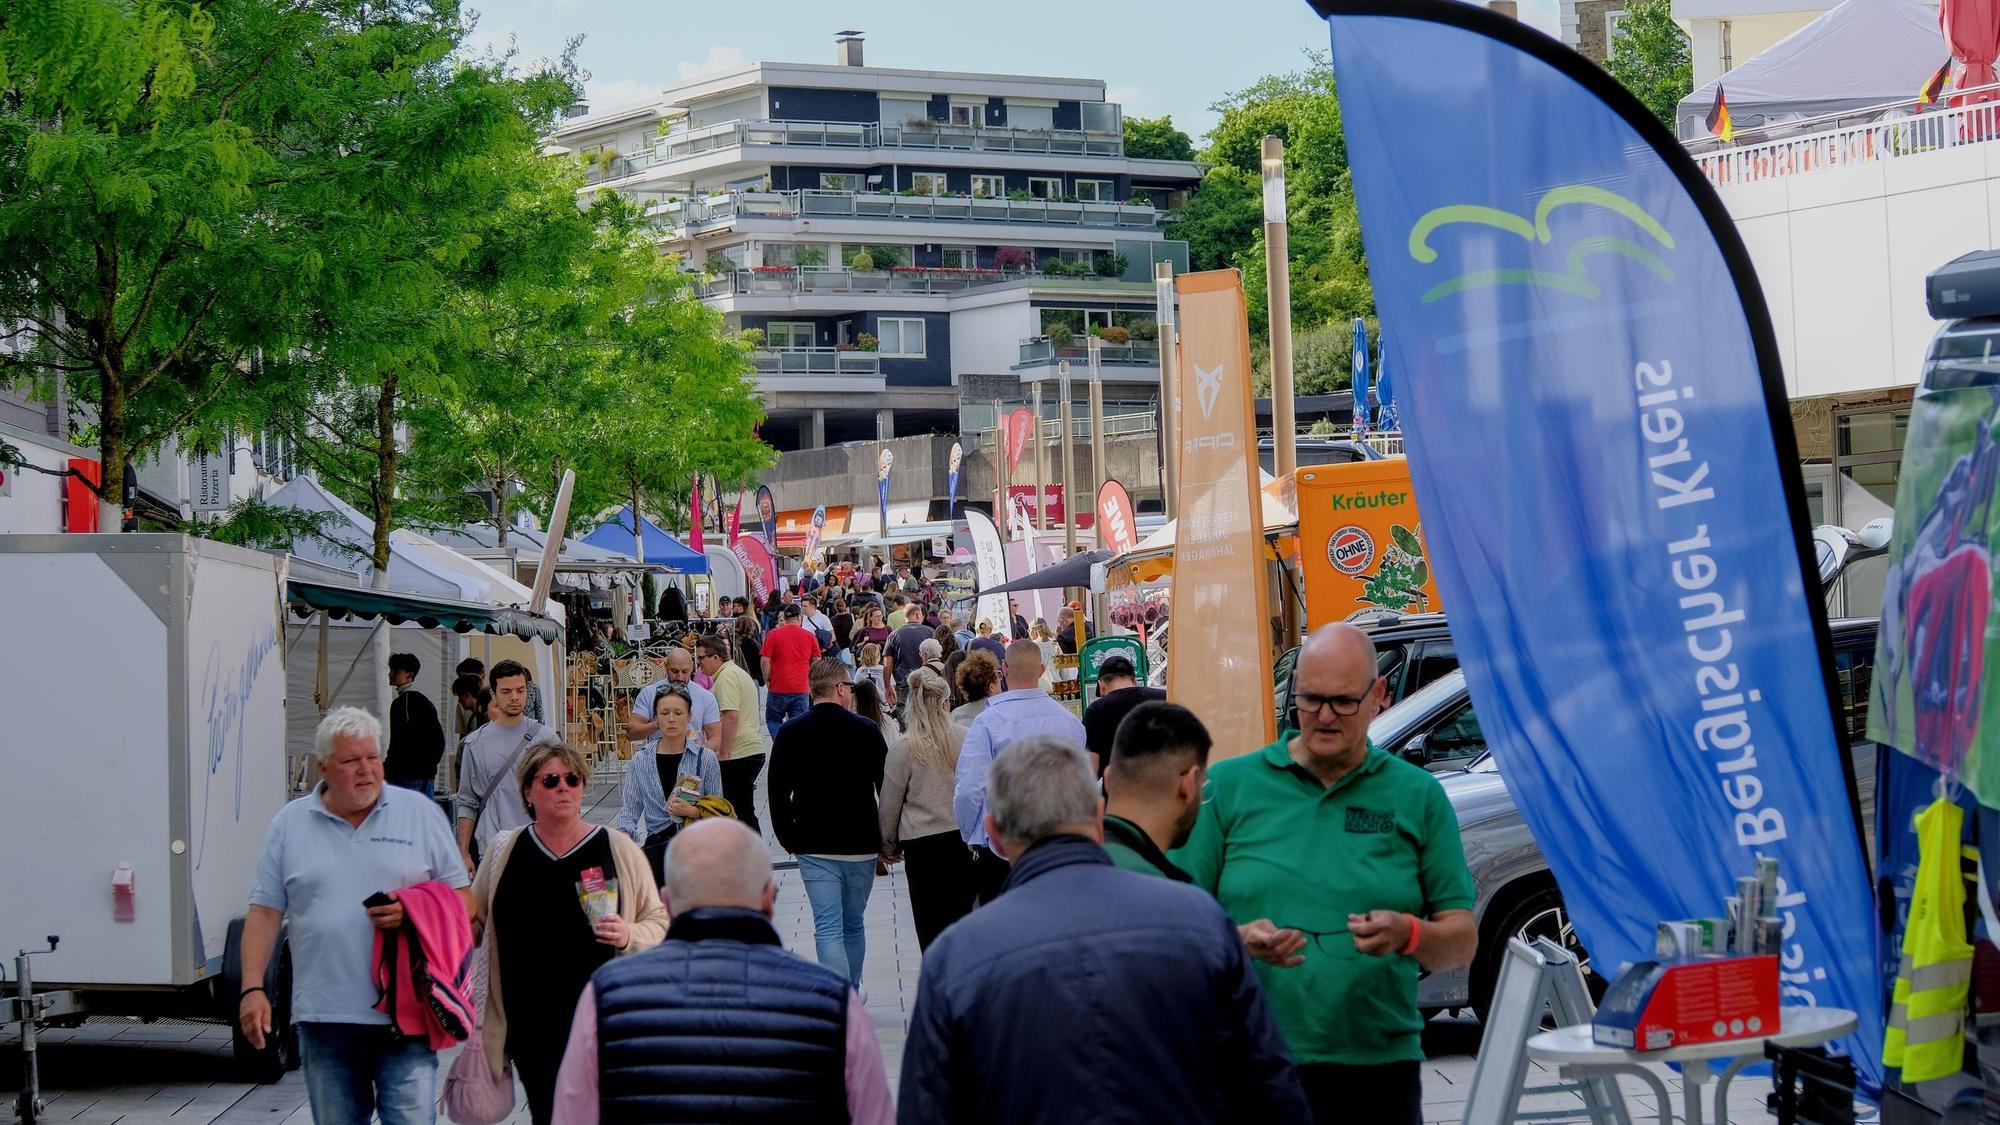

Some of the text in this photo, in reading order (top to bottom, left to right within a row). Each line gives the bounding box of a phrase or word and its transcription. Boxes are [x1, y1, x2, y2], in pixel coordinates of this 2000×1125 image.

[211, 469, 219, 505] Pizzeria
[1332, 490, 1408, 511] Kräuter
[1336, 539, 1367, 560] OHNE
